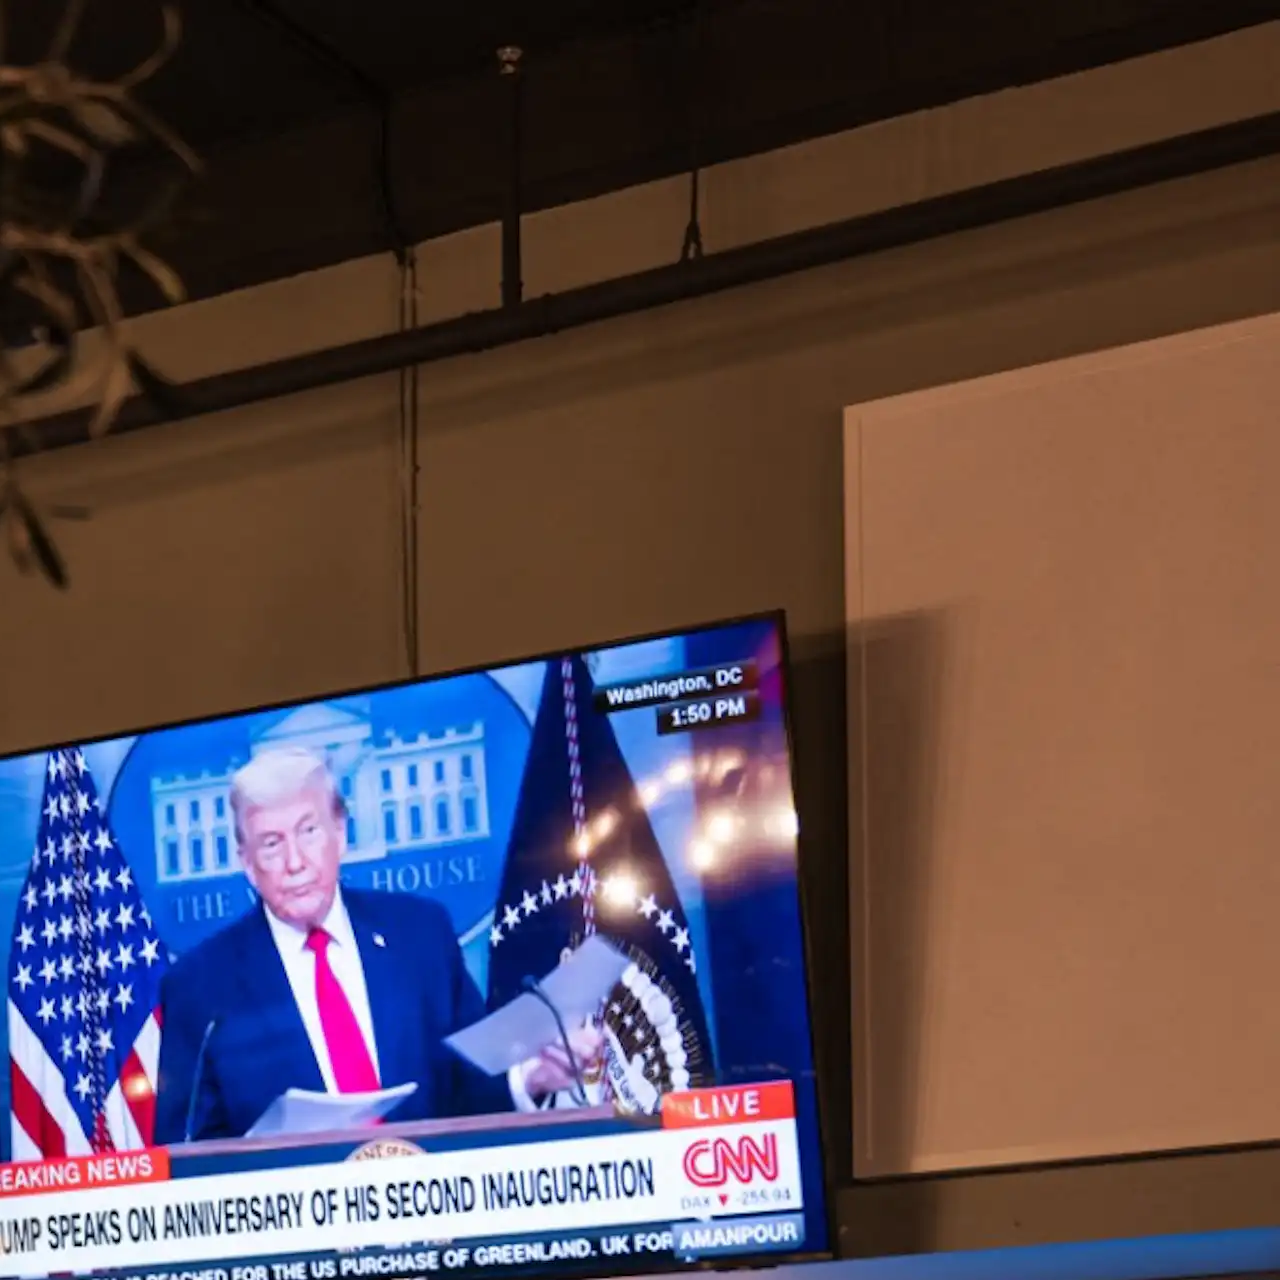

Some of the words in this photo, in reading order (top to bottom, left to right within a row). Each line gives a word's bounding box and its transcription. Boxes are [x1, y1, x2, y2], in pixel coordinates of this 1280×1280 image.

[606, 674, 712, 705] Washington,
[716, 666, 743, 686] DC
[672, 702, 711, 726] 1:50
[716, 696, 746, 718] PM
[175, 890, 234, 923] THE
[372, 855, 485, 893] HOUSE
[693, 1089, 761, 1120] LIVE
[86, 1154, 153, 1181] NEWS
[683, 1132, 780, 1188] CNN
[47, 1208, 122, 1250] SPEAKS
[127, 1205, 158, 1242] ON
[163, 1193, 304, 1240] ANNIVERSARY
[310, 1189, 339, 1226] OF
[344, 1185, 381, 1222] HIS
[385, 1176, 476, 1220] SECOND
[481, 1157, 655, 1211] INAUGURATION
[310, 1257, 336, 1279] US
[340, 1248, 439, 1277] PURCHASE
[443, 1246, 470, 1269] OF
[474, 1239, 598, 1266] GREENLAND.
[601, 1235, 629, 1255] UK
[633, 1230, 671, 1253] FOR
[679, 1220, 798, 1251] AMANPOUR
